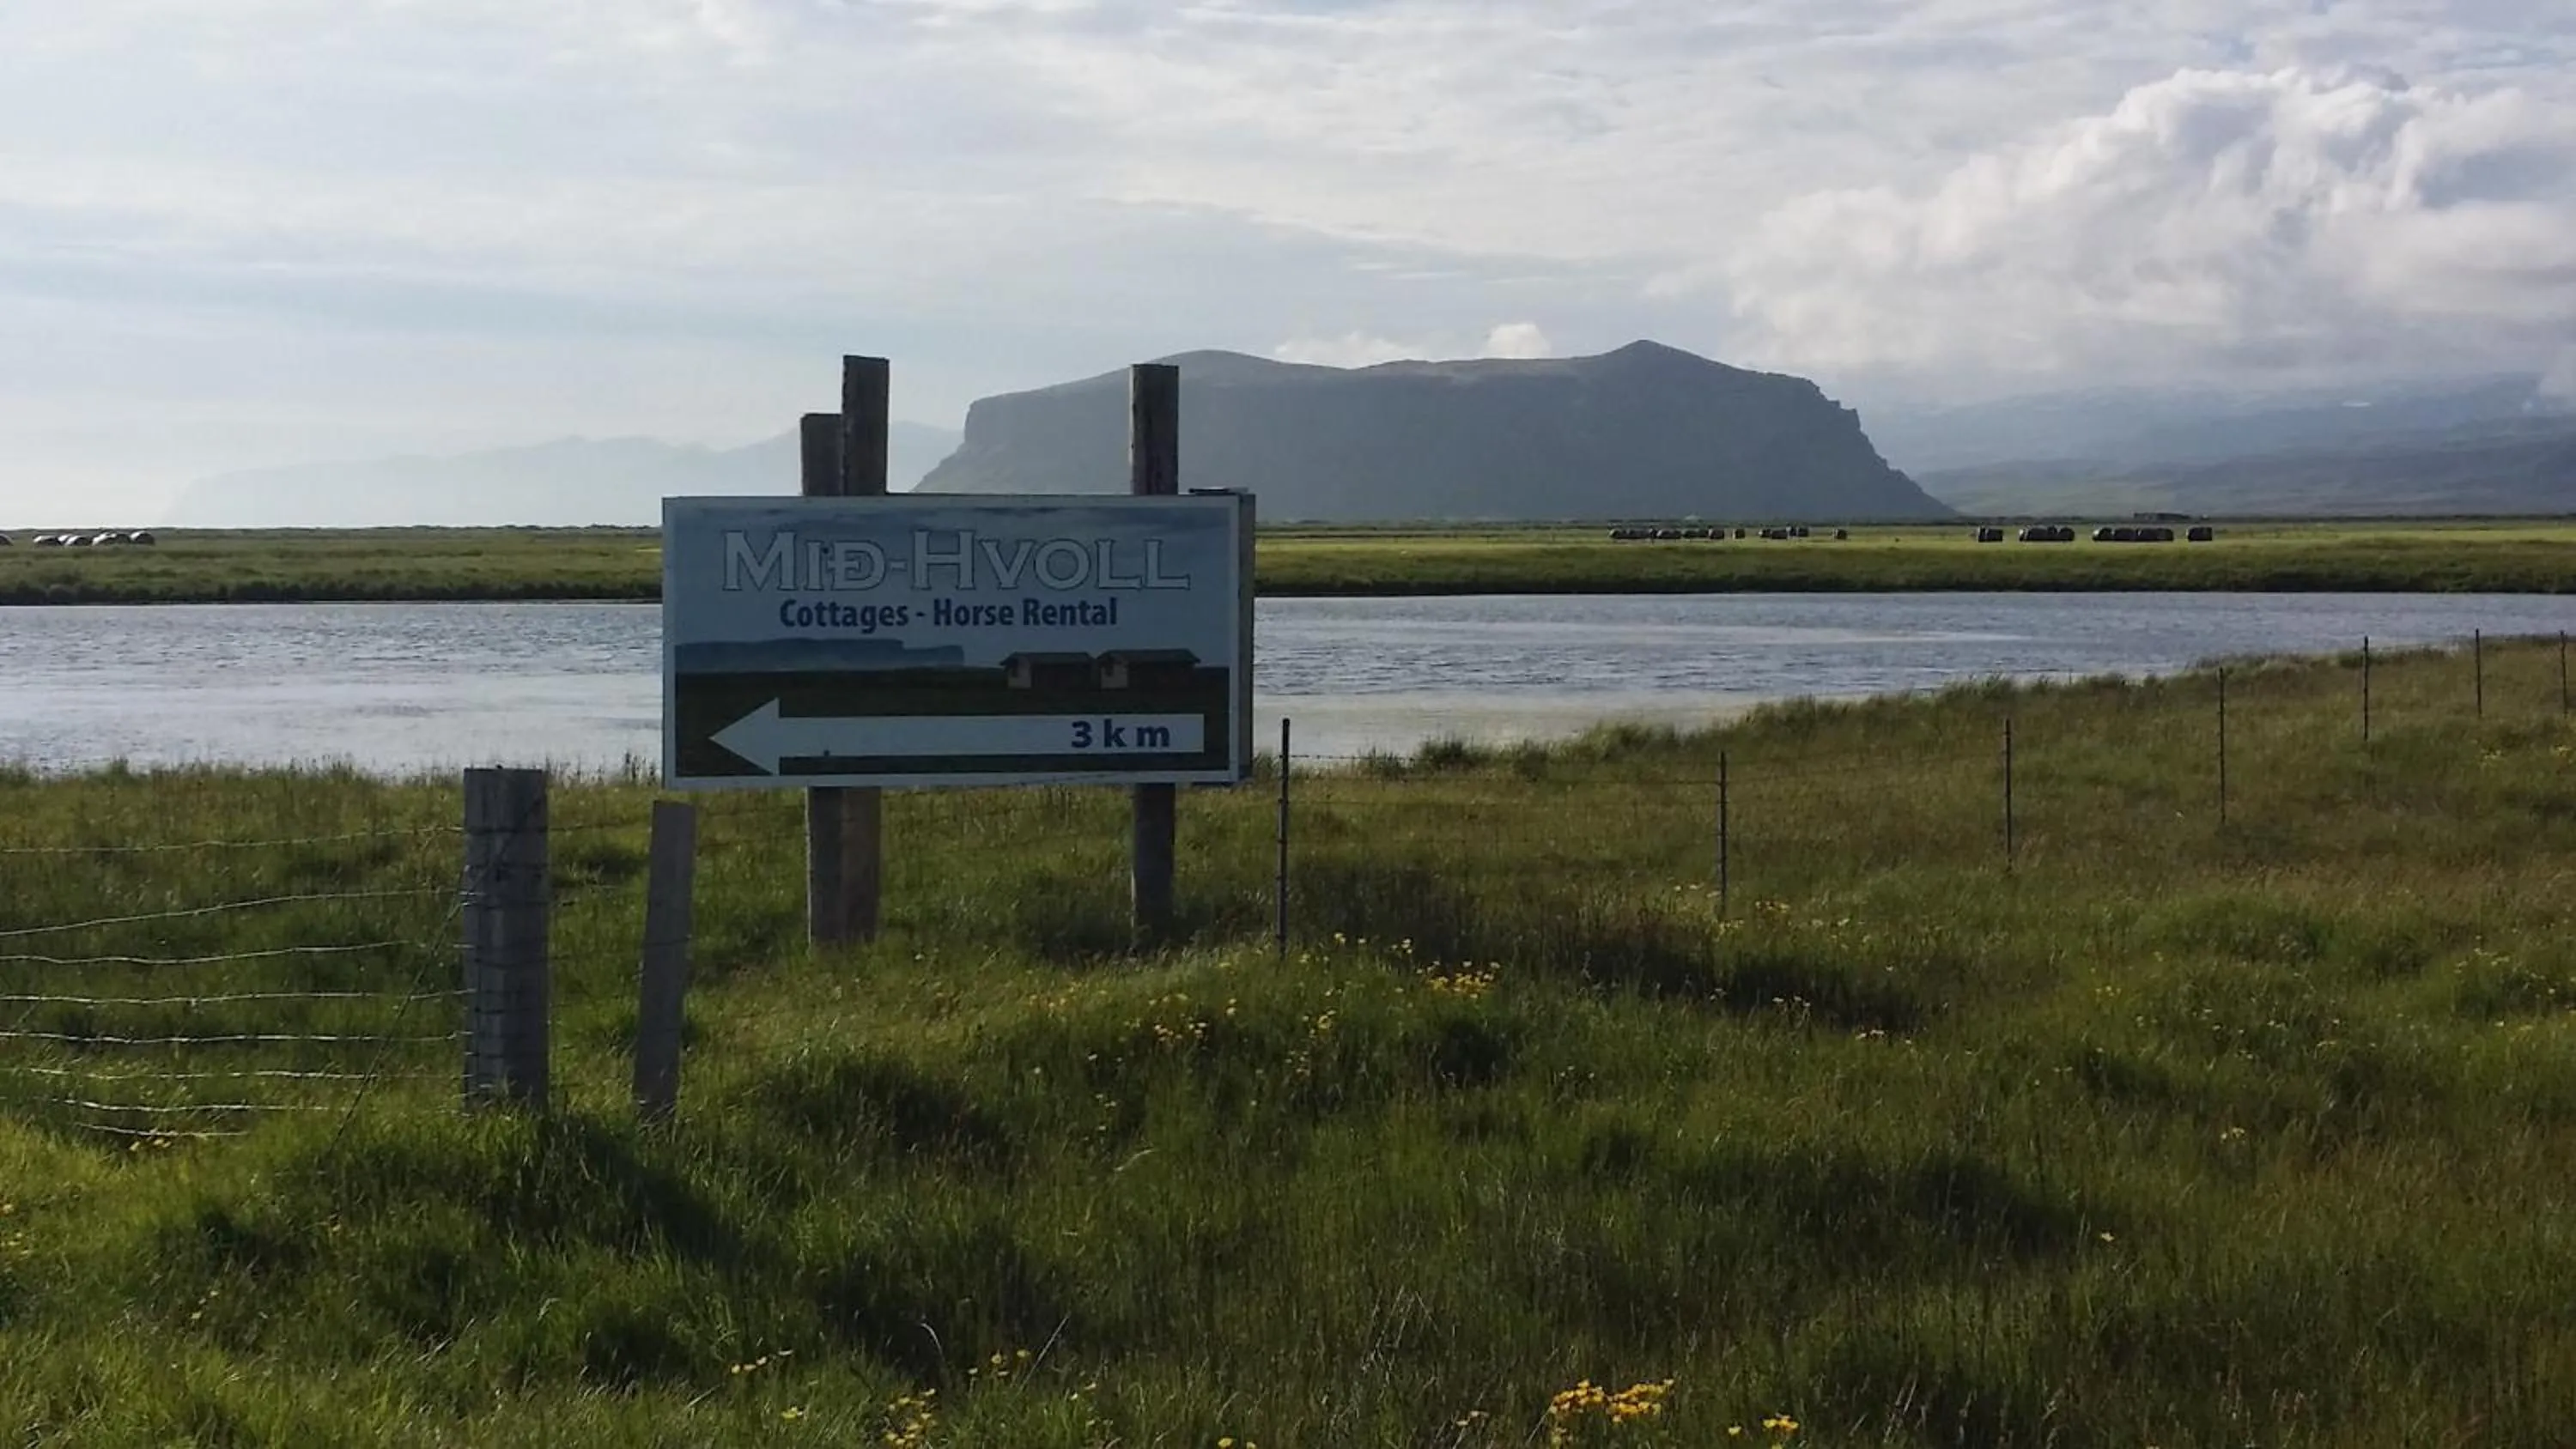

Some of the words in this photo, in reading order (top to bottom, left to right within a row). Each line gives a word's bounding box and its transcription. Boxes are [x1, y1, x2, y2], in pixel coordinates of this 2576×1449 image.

[779, 599, 909, 634] Cottages
[933, 598, 1015, 627] Horse
[1022, 597, 1118, 627] Rental
[1070, 720, 1092, 749] 3
[1103, 718, 1170, 749] km
